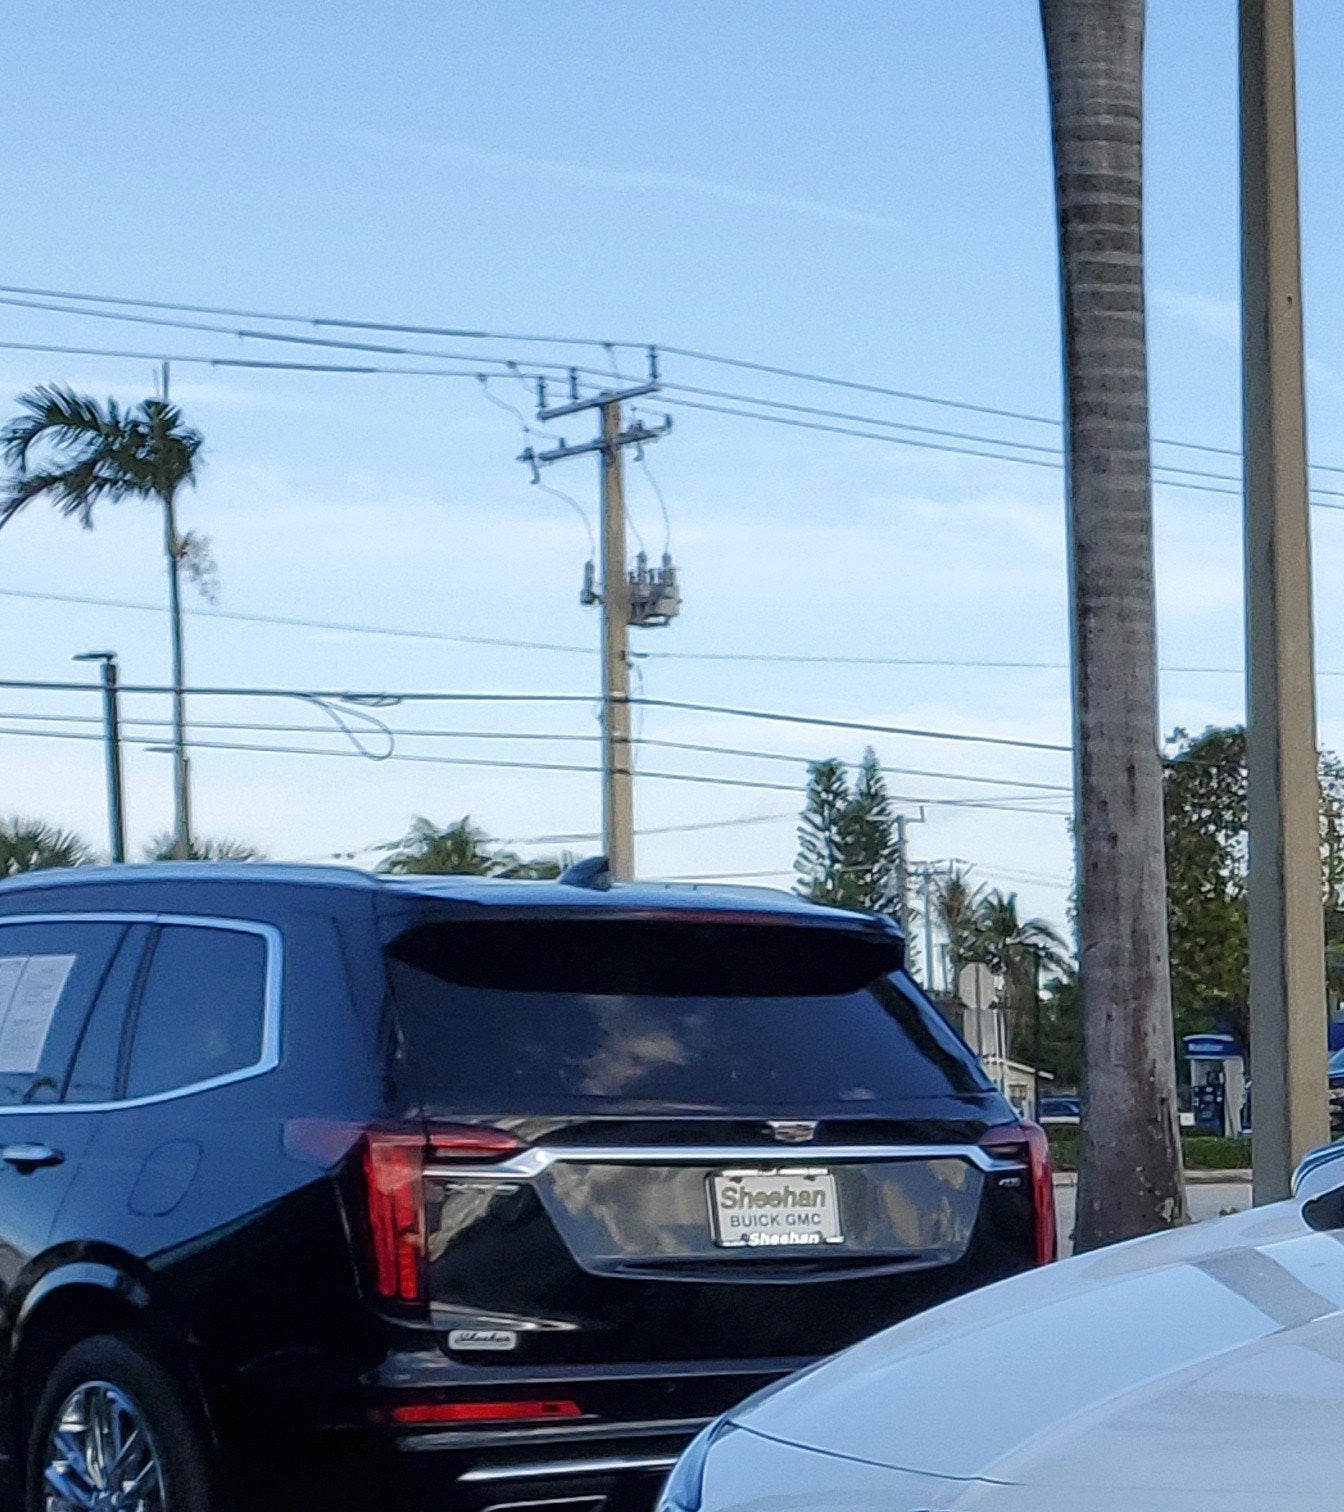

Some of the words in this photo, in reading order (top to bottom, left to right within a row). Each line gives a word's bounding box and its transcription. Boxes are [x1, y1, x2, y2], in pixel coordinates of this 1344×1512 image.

[720, 1185, 827, 1210] Sheehan
[730, 1214, 780, 1228] BUICK
[785, 1213, 822, 1227] GMC
[749, 1231, 820, 1246] Sheehan
